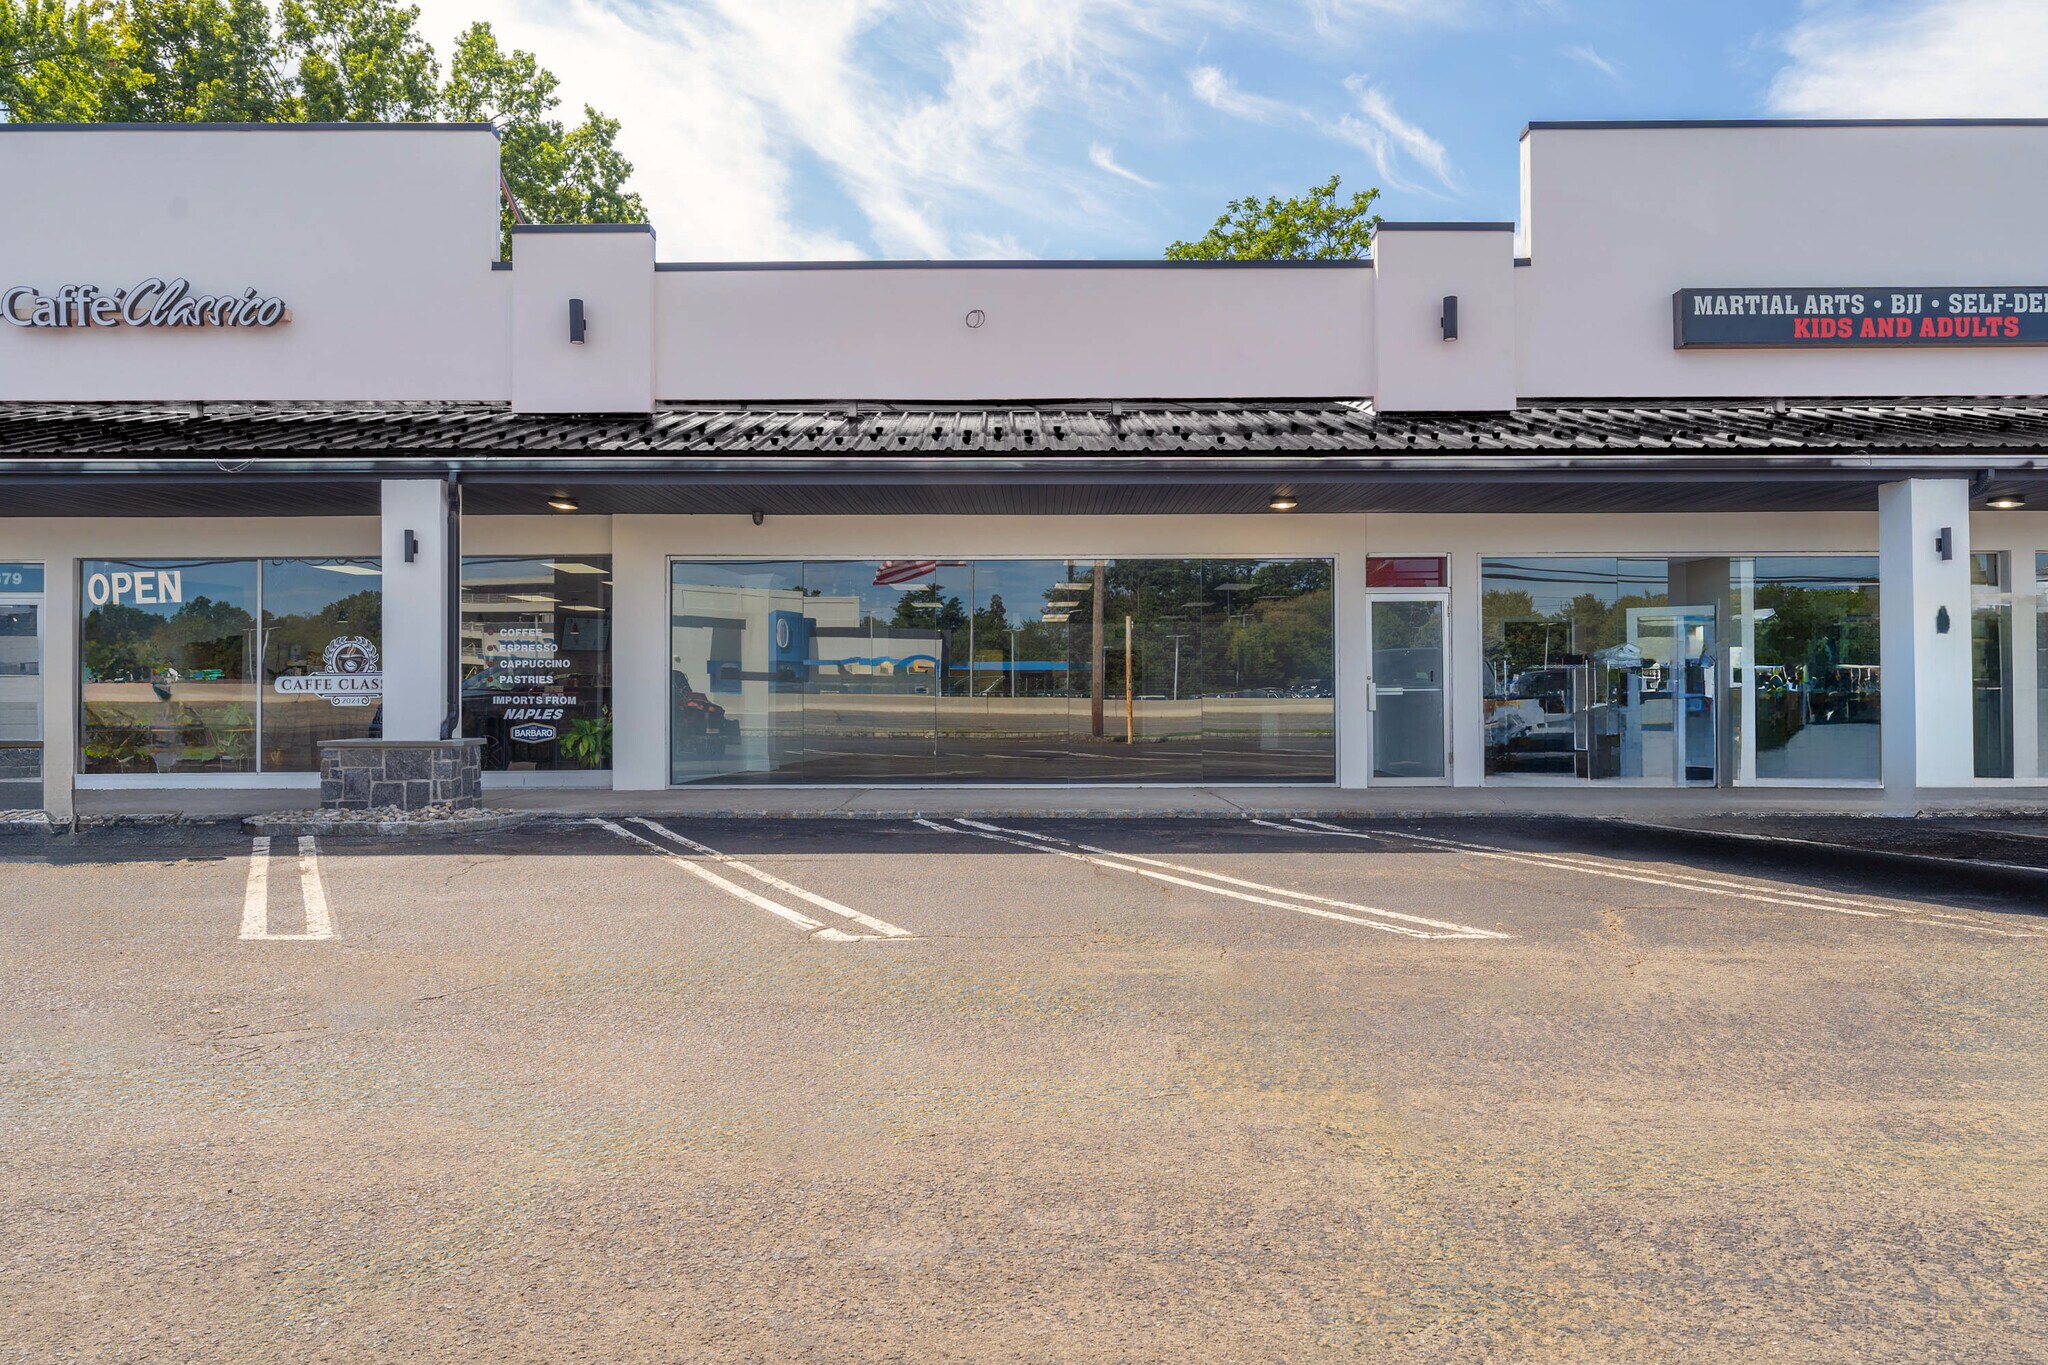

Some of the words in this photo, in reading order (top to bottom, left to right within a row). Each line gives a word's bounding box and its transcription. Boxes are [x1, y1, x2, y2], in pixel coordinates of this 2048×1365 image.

[122, 277, 286, 327] Classico
[1694, 295, 1799, 316] MARTIAL
[1804, 294, 1865, 316] ARTS
[1891, 294, 1922, 315] BJJ
[1949, 293, 2048, 314] SELF-DE
[1794, 317, 1853, 338] KIDS
[1860, 317, 1912, 338] AND
[1919, 316, 2020, 338] ADULTS
[0, 572, 23, 585] 79
[88, 570, 182, 606] OPEN
[499, 628, 543, 637] COFFEE
[499, 643, 558, 652] ESPRESSO
[499, 659, 571, 668] CAPPUCCINO
[281, 678, 333, 690] CAFFE
[338, 678, 382, 690] CLAS
[499, 675, 554, 684] PASTRIES
[492, 696, 543, 705] IMPORTS
[545, 696, 577, 705] FROM
[503, 708, 564, 720] NAPLES
[514, 729, 553, 737] BARBARO
